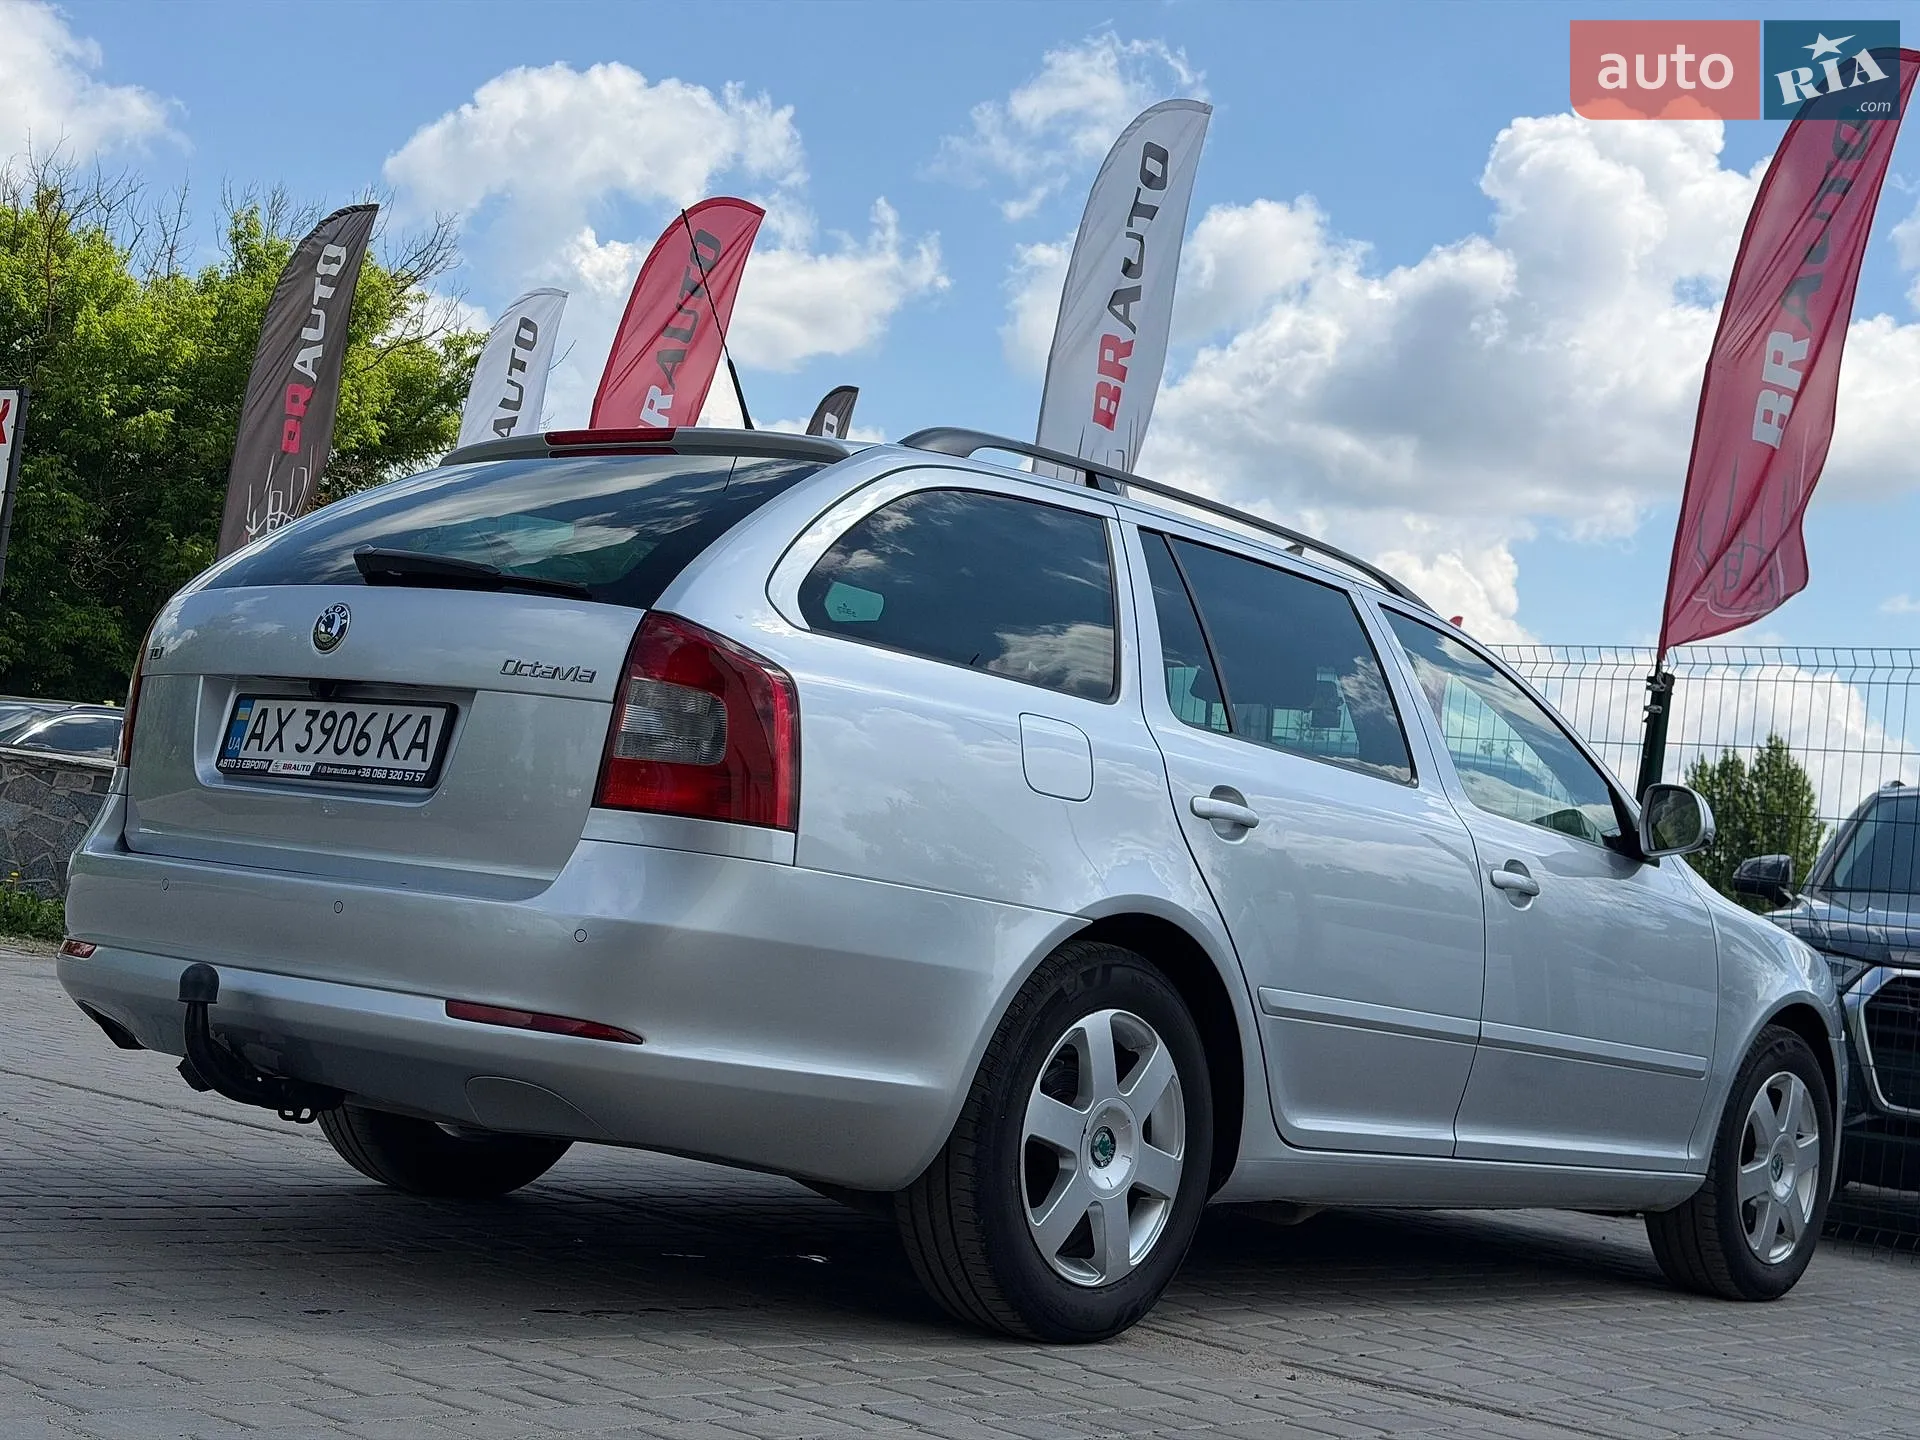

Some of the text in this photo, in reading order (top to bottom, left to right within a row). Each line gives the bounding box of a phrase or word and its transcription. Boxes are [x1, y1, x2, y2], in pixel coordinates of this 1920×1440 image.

[1092, 140, 1169, 433] BRAUTO
[638, 228, 722, 428] RAUTO
[280, 243, 347, 455] BRAUTO
[499, 658, 597, 684] Octavia
[228, 736, 241, 751] UA
[243, 707, 433, 763] AX 3906 KA
[282, 763, 312, 773] BRAUTO
[388, 770, 404, 780] 320
[404, 771, 416, 781] 57
[414, 772, 426, 782] 57
